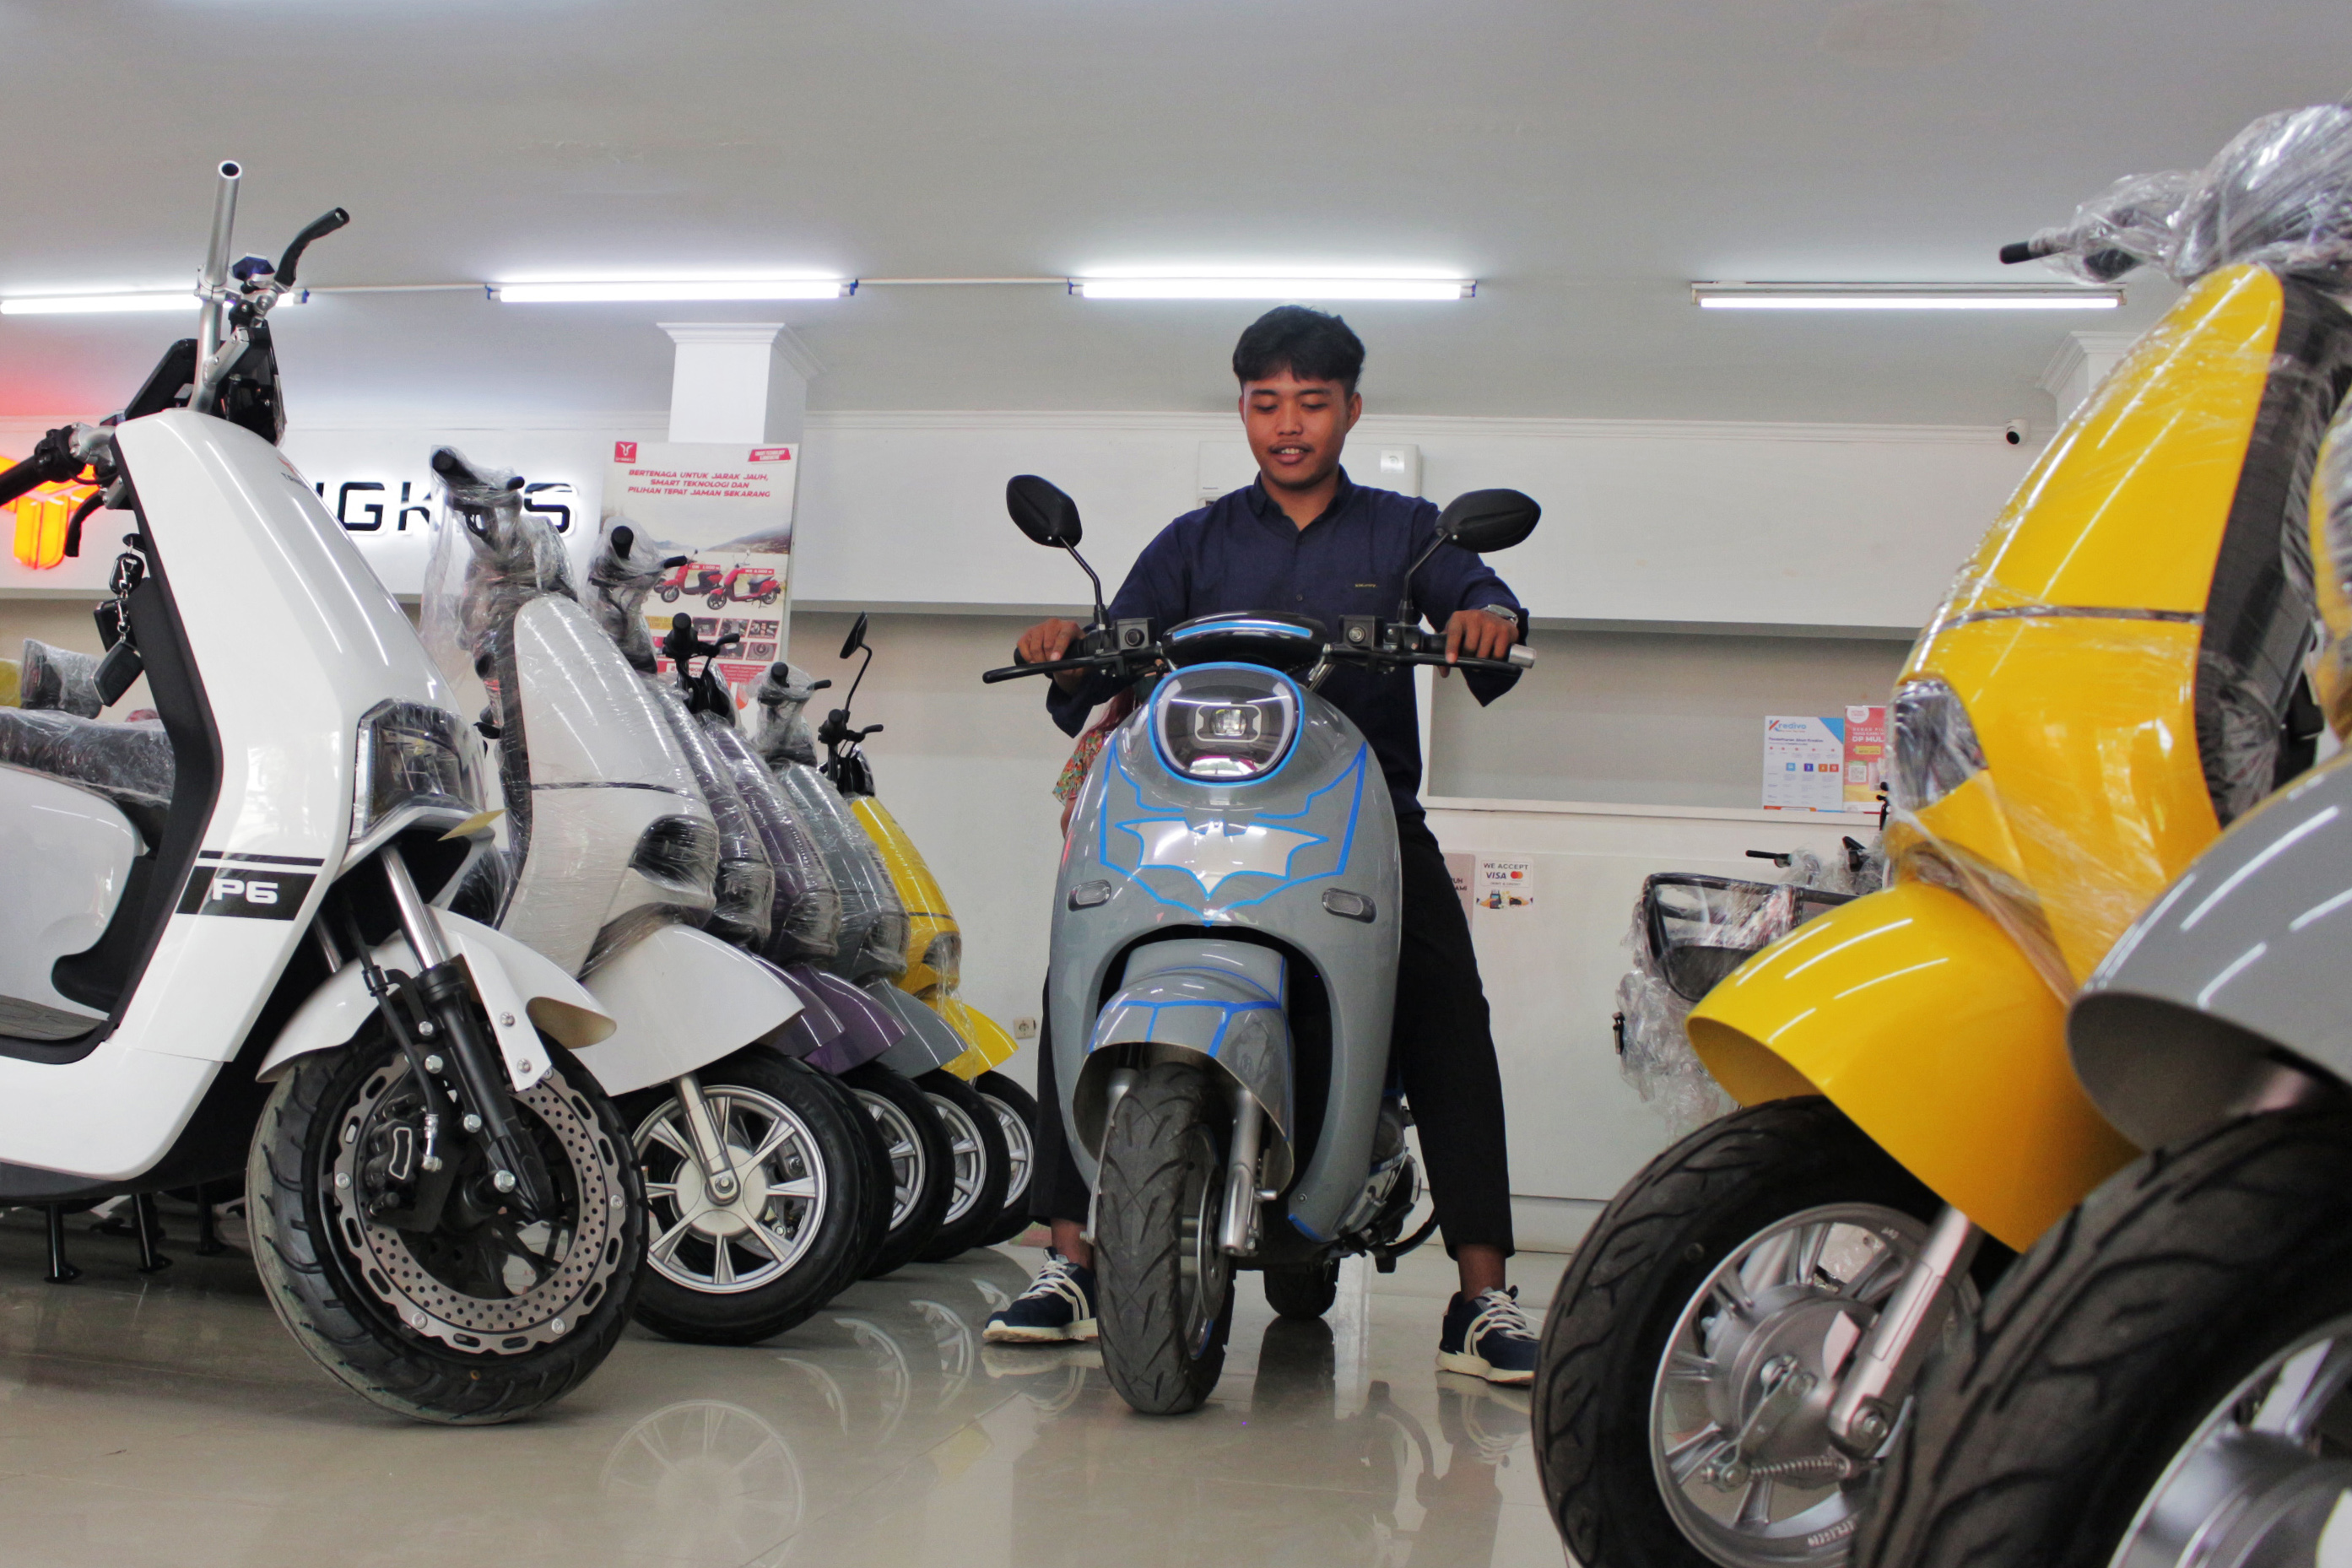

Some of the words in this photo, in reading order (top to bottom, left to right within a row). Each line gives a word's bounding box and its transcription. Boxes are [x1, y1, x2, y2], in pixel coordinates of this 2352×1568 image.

[629, 469, 677, 478] BERTENAGA
[743, 473, 769, 482] JAUH,
[1769, 720, 1807, 732] Kredivo
[212, 878, 278, 904] P6
